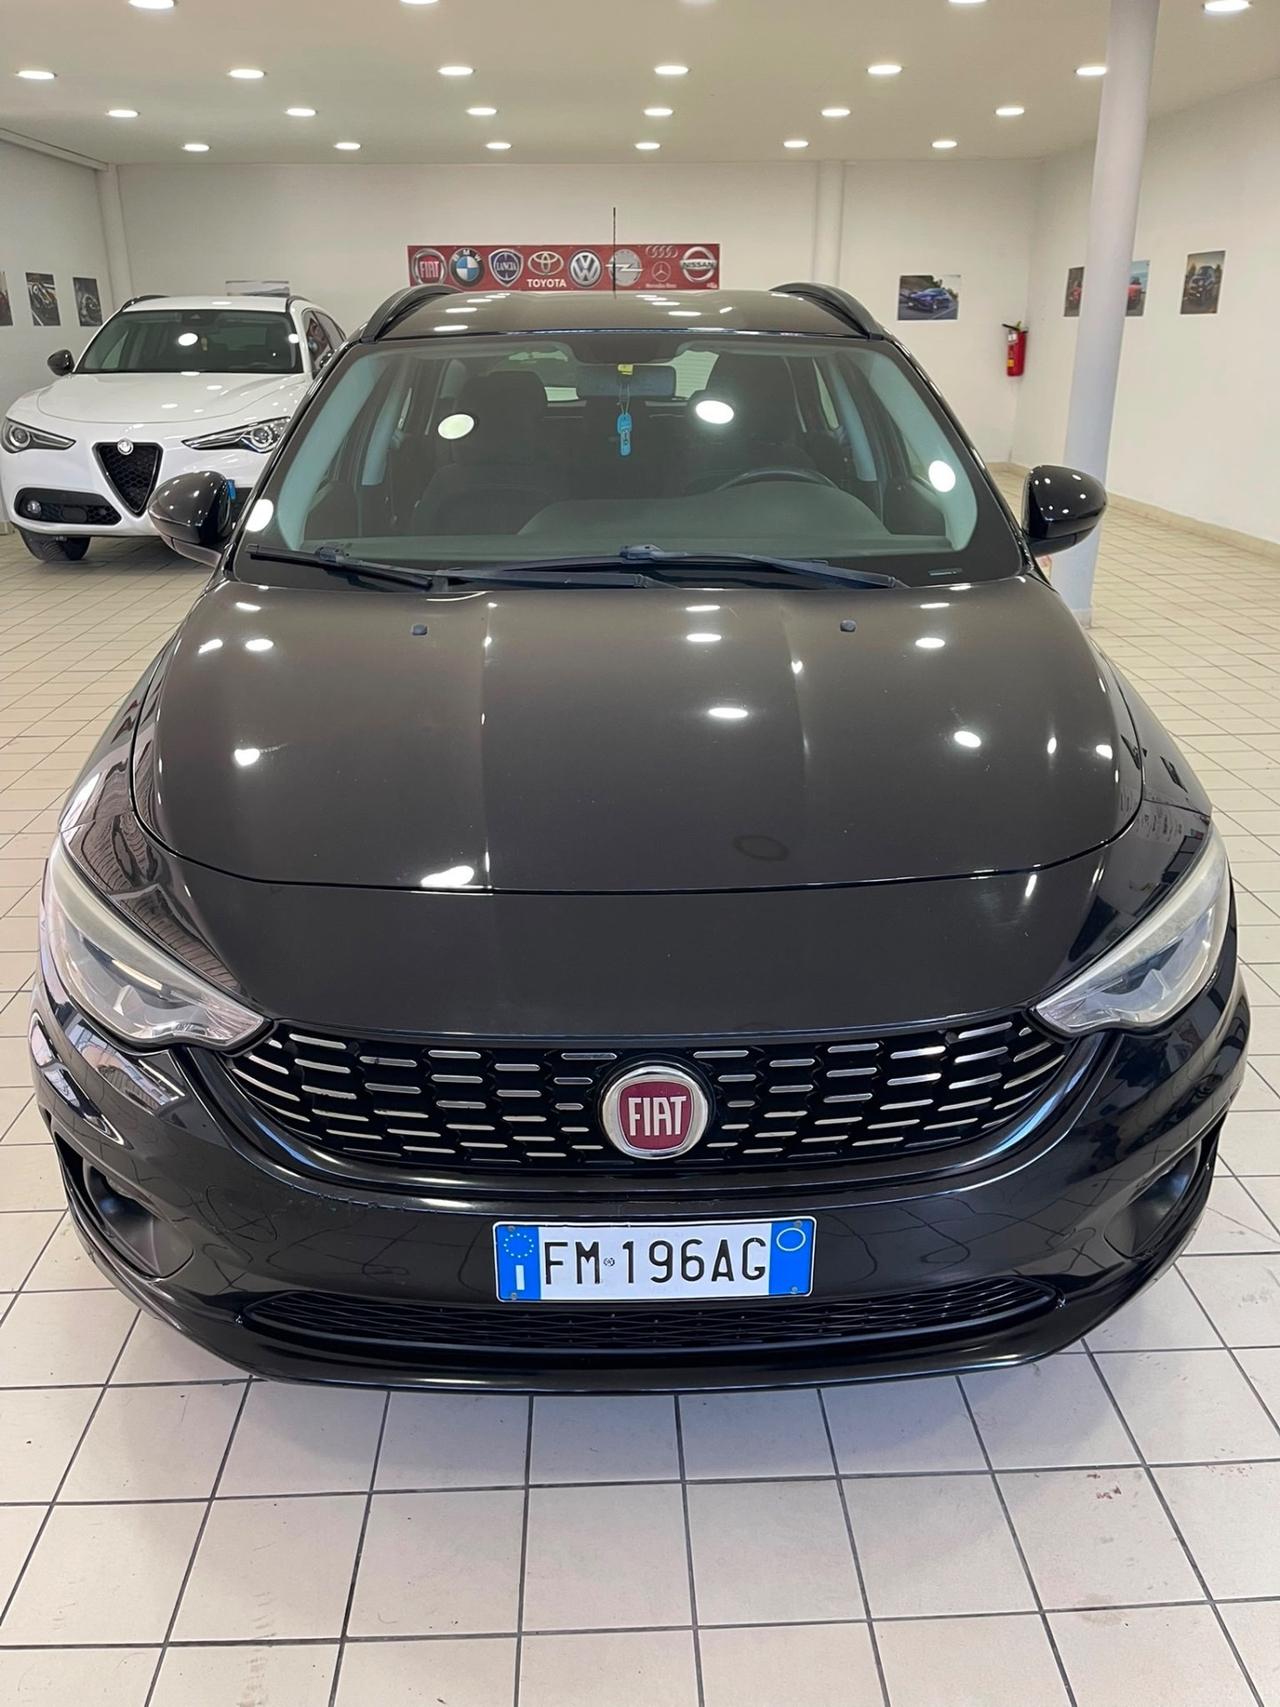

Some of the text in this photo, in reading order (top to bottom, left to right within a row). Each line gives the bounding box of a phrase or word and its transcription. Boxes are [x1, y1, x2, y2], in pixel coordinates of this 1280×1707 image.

[452, 249, 481, 262] BMW
[419, 261, 440, 278] FIAT
[682, 260, 715, 268] NISSAN
[527, 278, 567, 288] TOYOTA
[627, 1095, 687, 1137] FIAT
